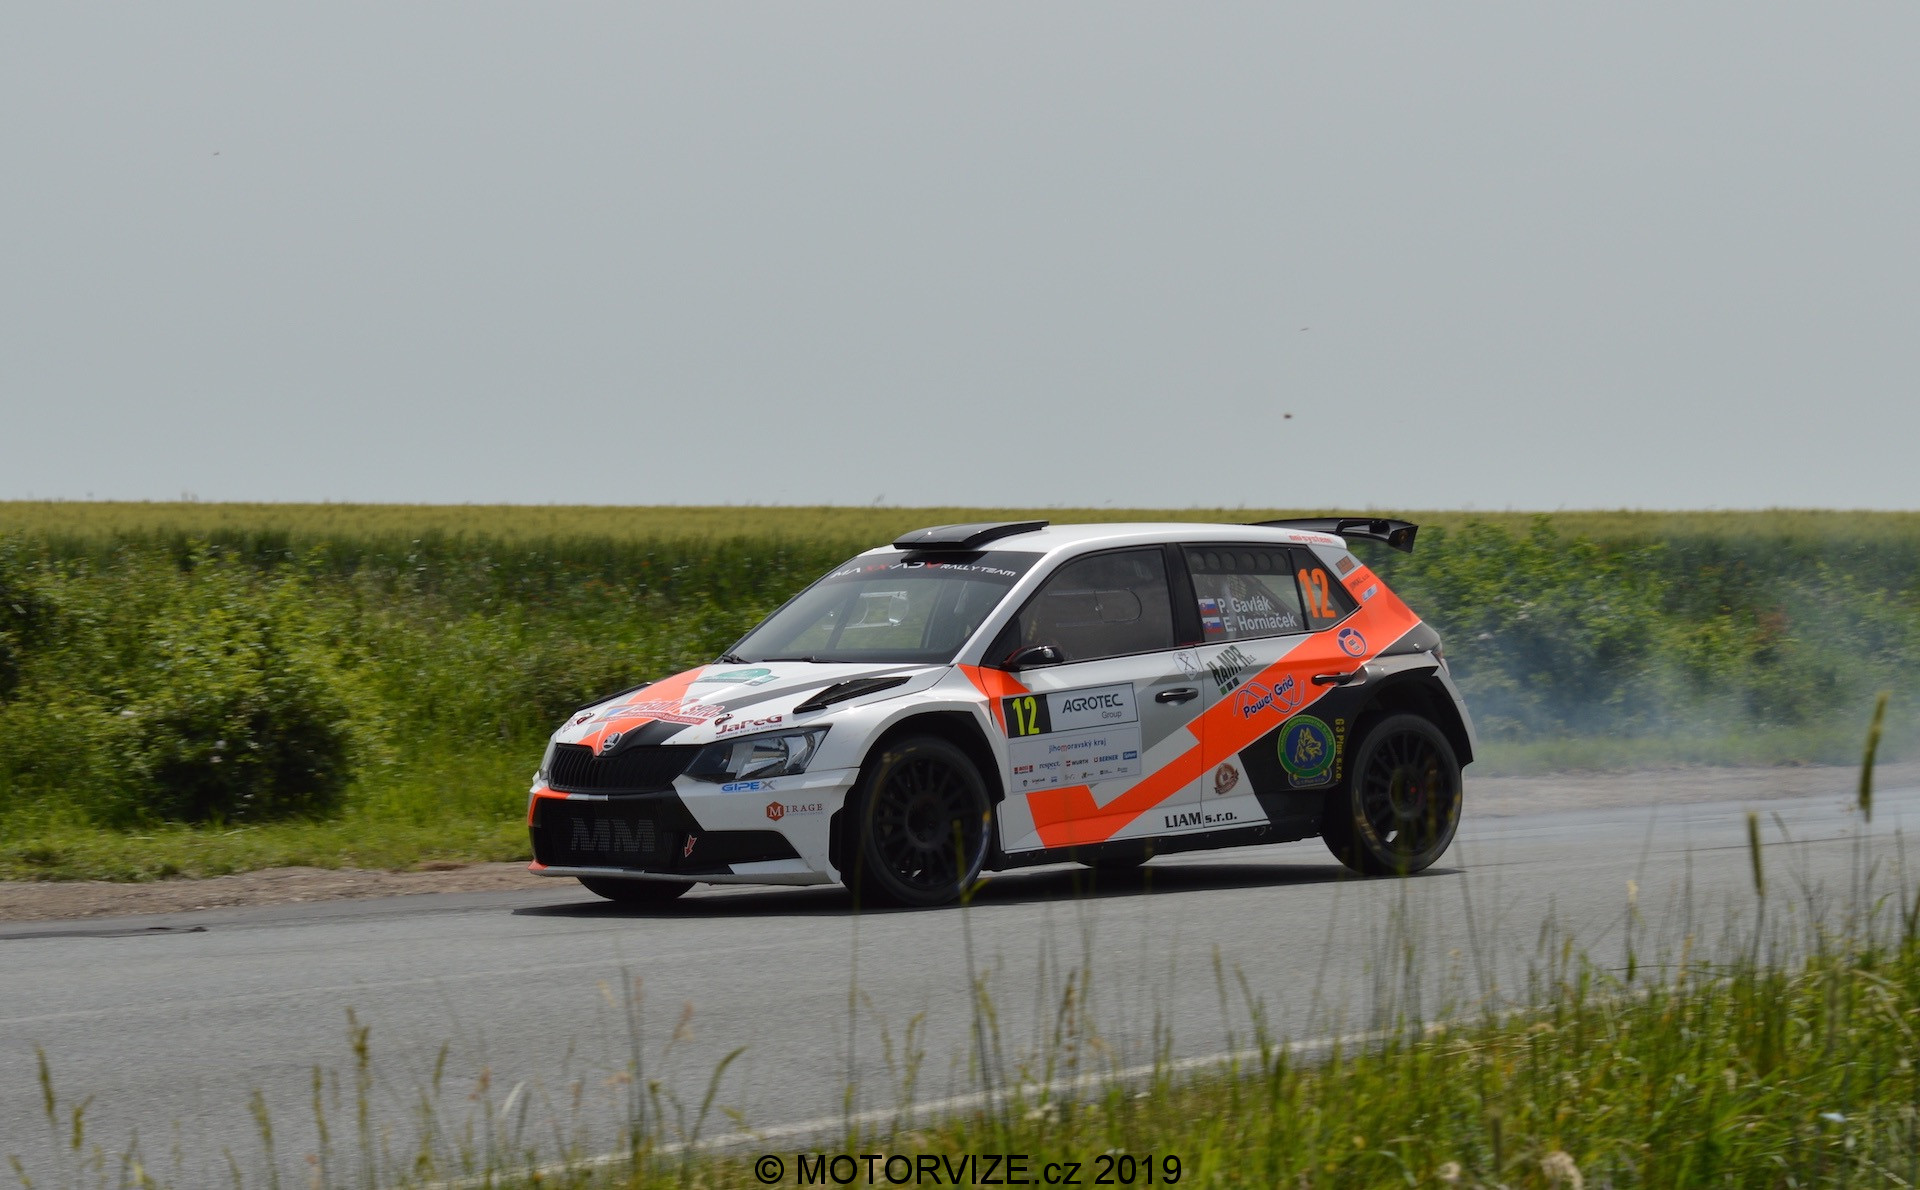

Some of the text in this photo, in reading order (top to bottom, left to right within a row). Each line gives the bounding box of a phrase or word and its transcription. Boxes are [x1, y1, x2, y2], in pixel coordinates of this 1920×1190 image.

[940, 563, 980, 572] RALLY
[981, 566, 1016, 577] TEAM
[1297, 567, 1336, 618] 12
[1216, 594, 1272, 614] P. Gavlák
[1222, 612, 1297, 633] E. Horniaček
[1062, 693, 1124, 714] AGROTEC
[1242, 674, 1295, 719] Power Grid
[1012, 696, 1040, 736] 12
[1101, 710, 1122, 719] Group
[1048, 738, 1107, 754] jihomoravský kraj
[1336, 735, 1344, 755] Plus
[1099, 754, 1118, 763] BERNER
[721, 780, 775, 792] GIPEX
[767, 802, 823, 819] MIRAGE
[1165, 811, 1238, 829] LIAM s.r.o.
[571, 817, 656, 852] MM
